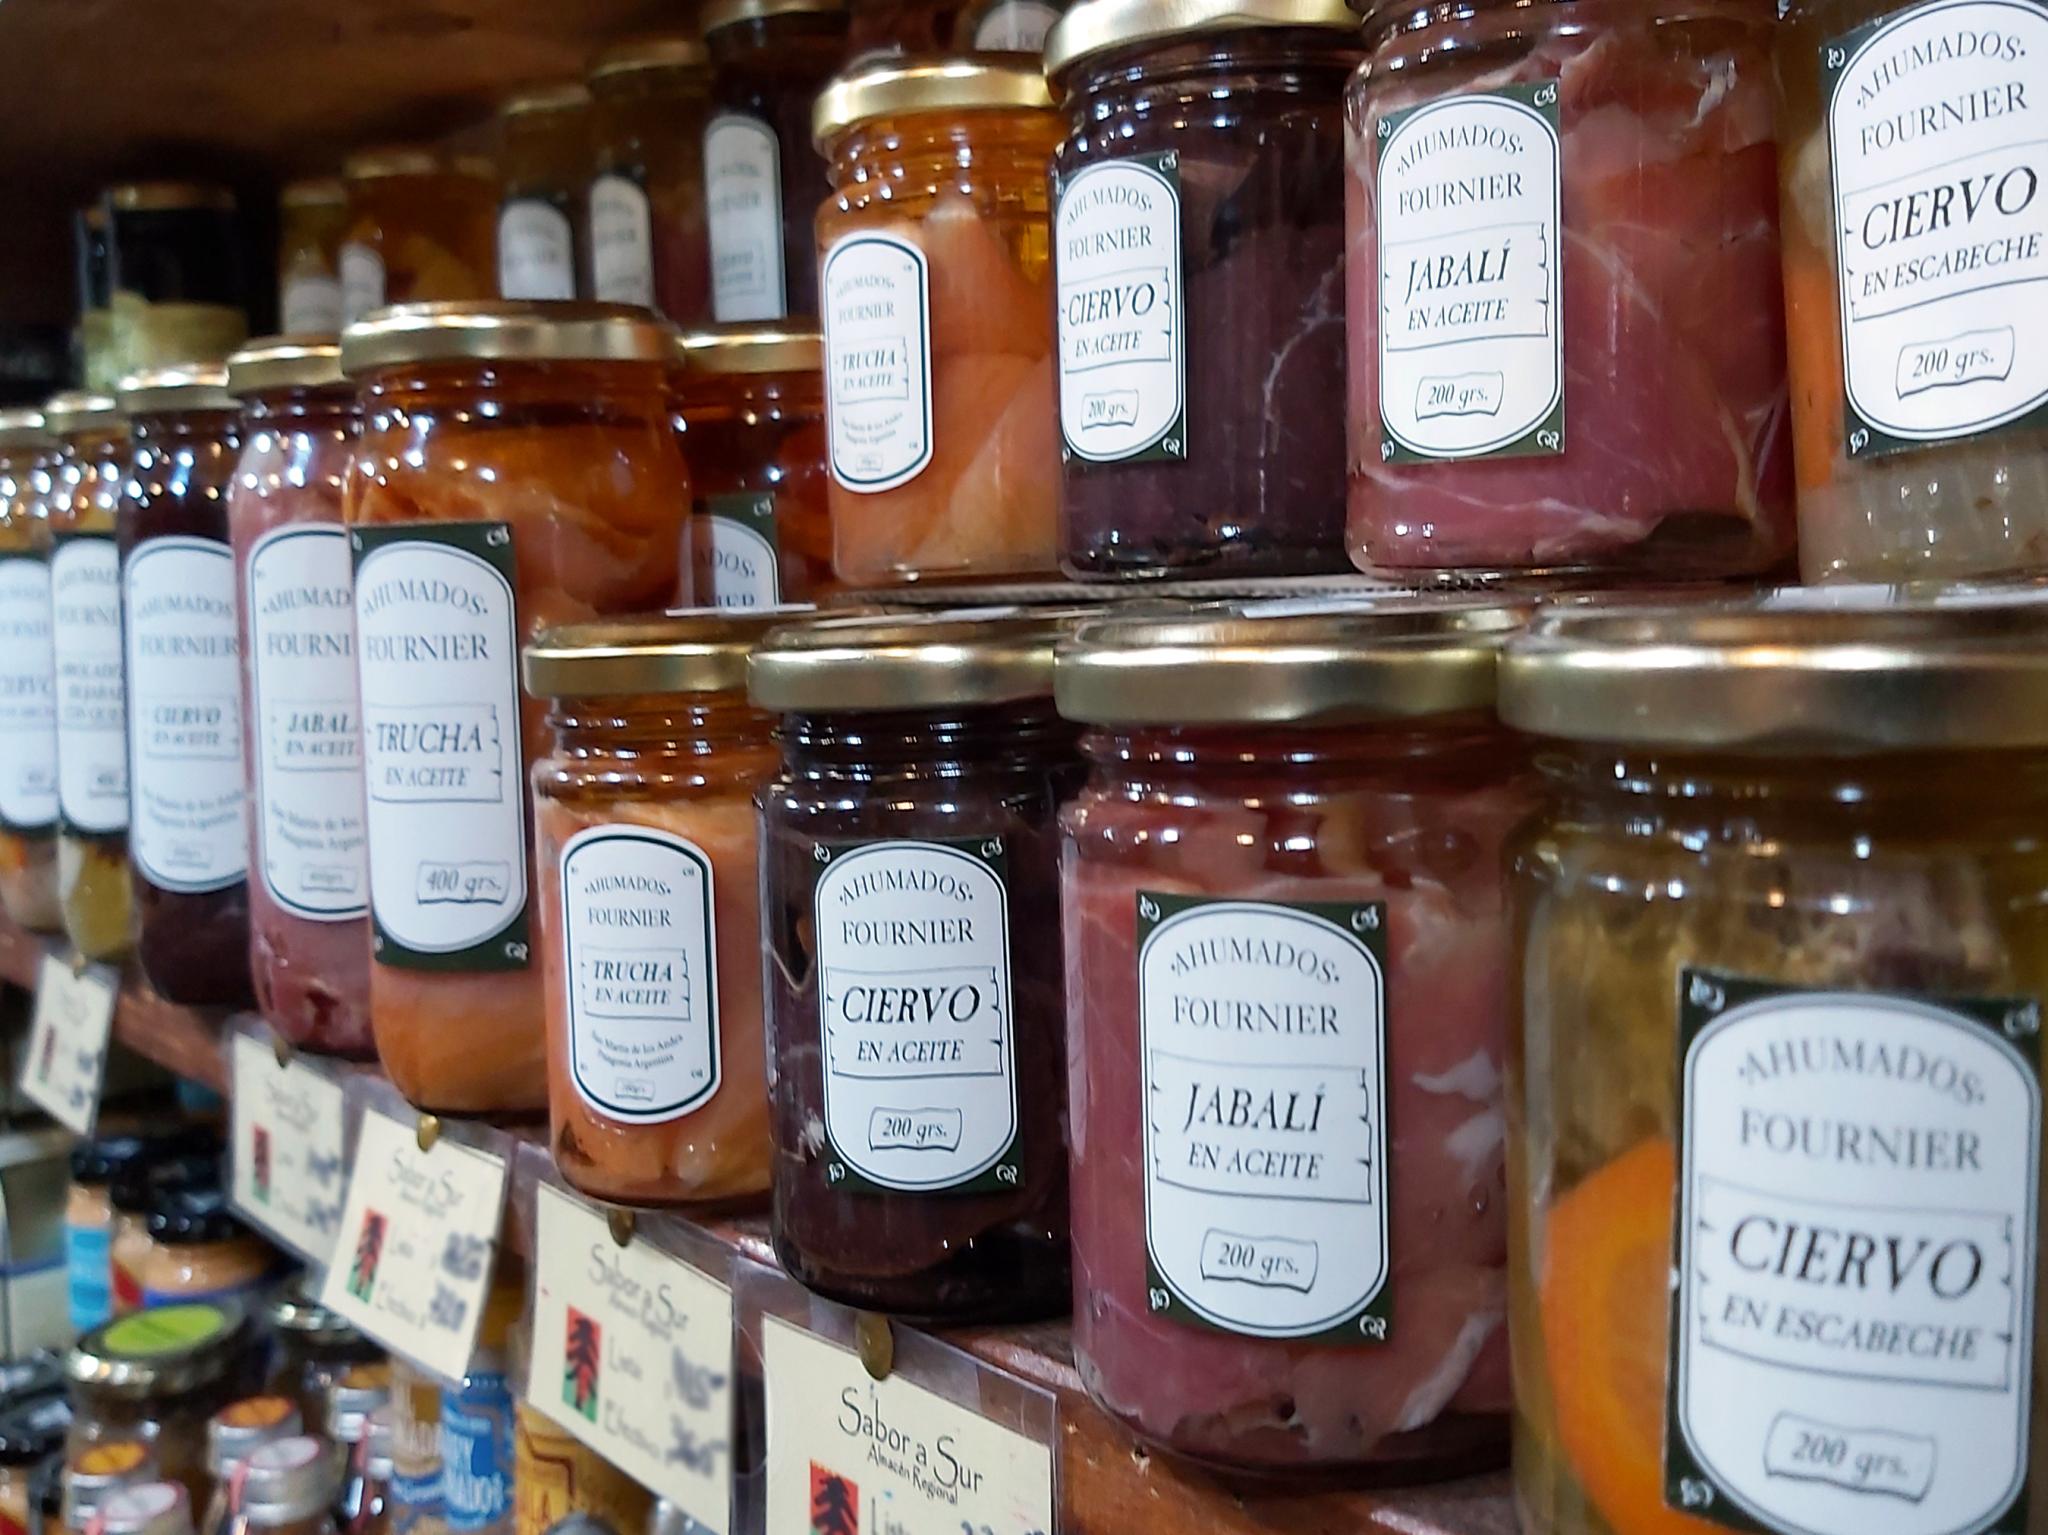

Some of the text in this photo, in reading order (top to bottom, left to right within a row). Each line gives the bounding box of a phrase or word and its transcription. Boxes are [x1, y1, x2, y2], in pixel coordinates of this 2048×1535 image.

[1861, 81, 2028, 156] FOURNIER
[1399, 171, 1523, 217] FOURNIER
[1863, 165, 2038, 250] CIERVO
[1068, 225, 1152, 261] FOURNIER
[1404, 238, 1511, 305] JABALÍ
[1863, 232, 2043, 297] EN ESCABECHE
[838, 301, 896, 326] FOURNIER
[1068, 282, 1156, 327] CIERVO
[1408, 298, 1509, 332] EN ACEITE
[842, 349, 896, 372] TRUCHA
[1075, 329, 1143, 358] EN ACEITE
[1912, 346, 1996, 378] 200 grs.
[1088, 400, 1106, 419] 200
[1427, 383, 1454, 406] 200
[366, 633, 490, 661] FOURNIER
[376, 722, 483, 754] TRUCHA
[385, 766, 471, 787] EN ACEITE
[426, 868, 460, 891] 400
[588, 906, 672, 928] FOURNIER
[842, 917, 975, 946] FOURNIER
[594, 959, 673, 982] TRUCHA
[595, 987, 672, 1005] EN ACEITE
[841, 983, 981, 1026] CIERVO
[1174, 994, 1340, 1036] FOURNIER
[857, 1038, 965, 1063] EN ACEITE
[1183, 1081, 1327, 1135] JABALÍ
[882, 1117, 912, 1139] 200
[1738, 1107, 1984, 1172] FOURNIER
[1188, 1142, 1325, 1180] EN ACEITE
[1217, 1242, 1300, 1281] 200 grs.
[1729, 1214, 1984, 1303] CIERVO
[1722, 1293, 1980, 1362] EN ESCABECHE
[838, 1385, 984, 1494] Sabor a Sur
[1791, 1430, 1848, 1470] 200
[912, 1466, 959, 1507] Regional
